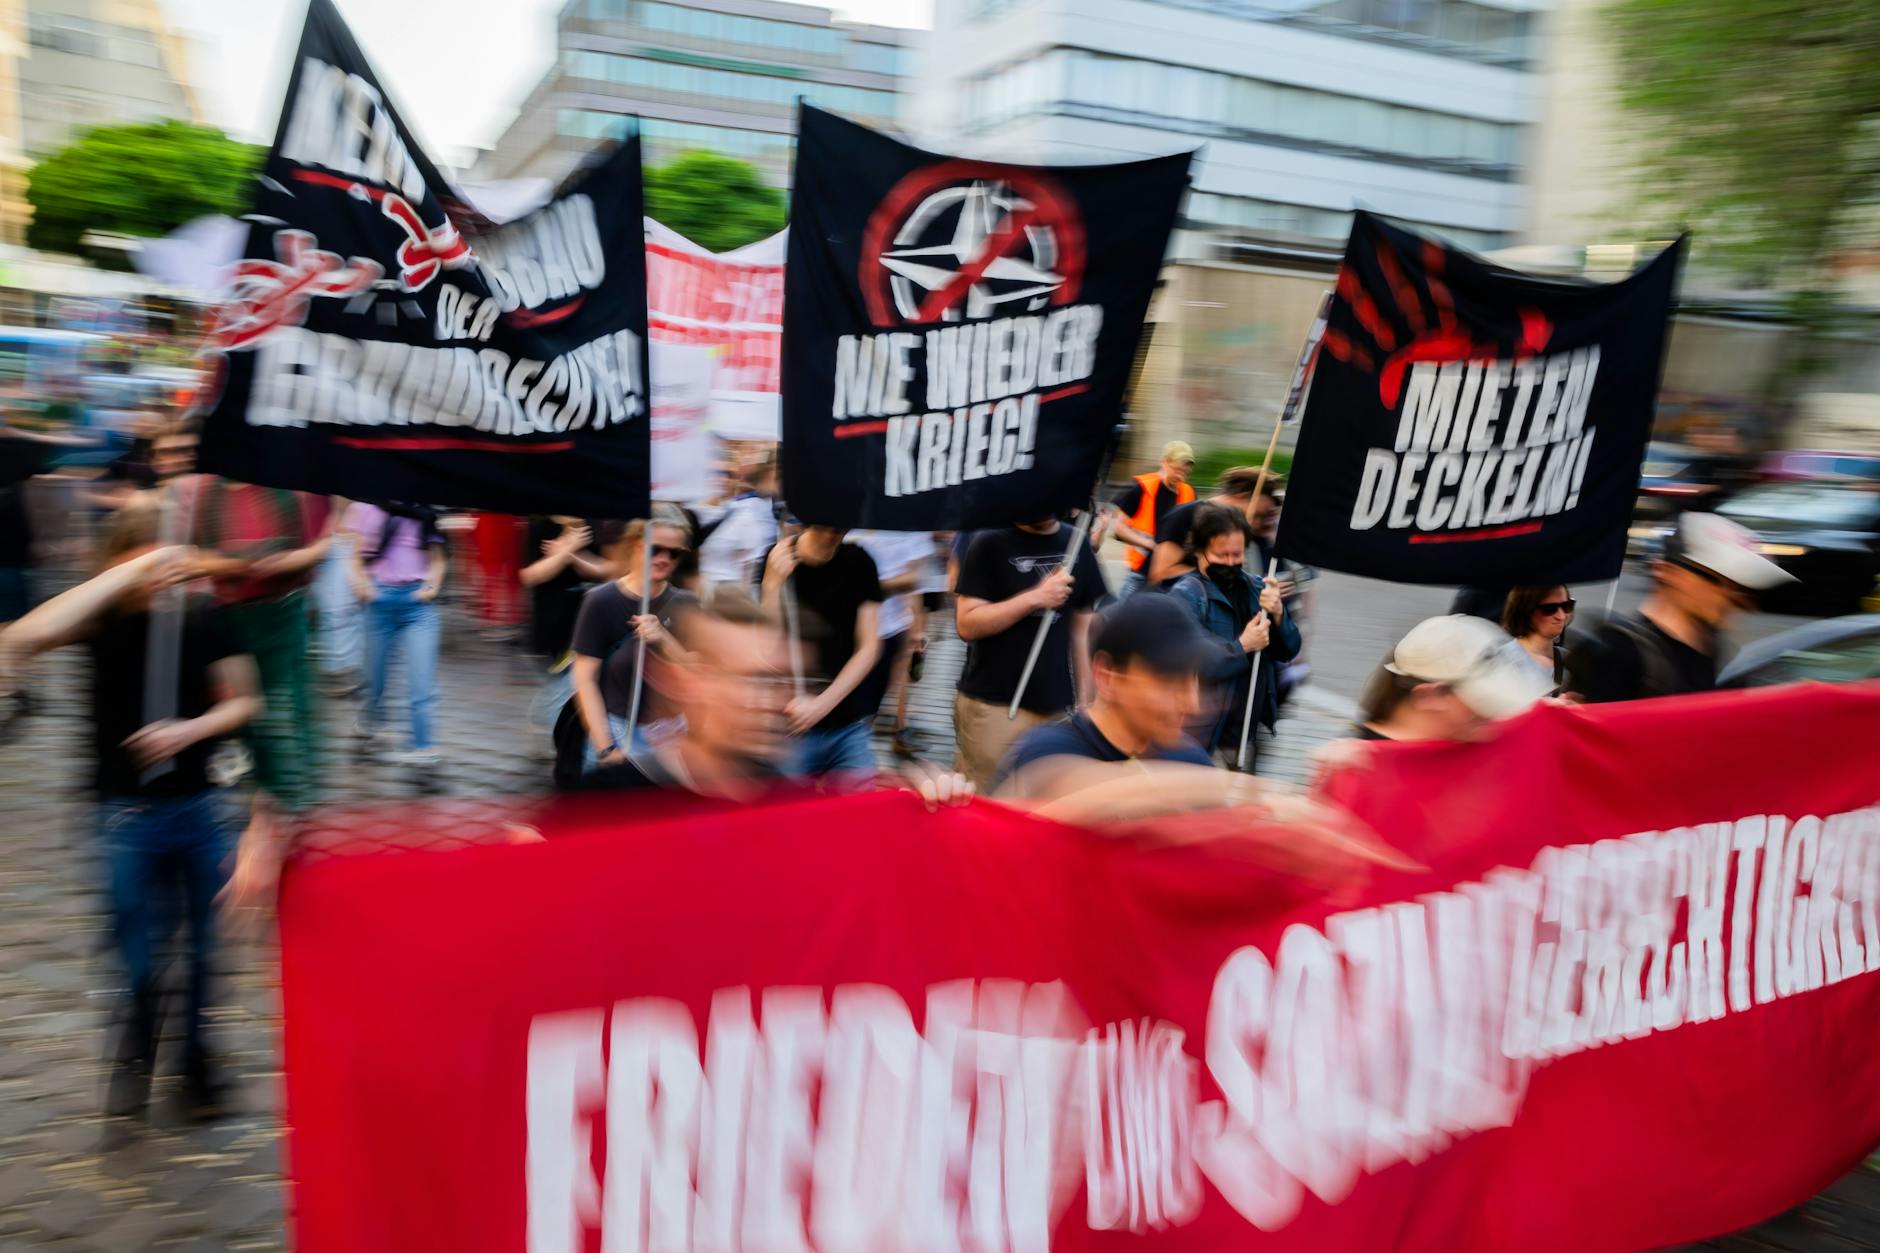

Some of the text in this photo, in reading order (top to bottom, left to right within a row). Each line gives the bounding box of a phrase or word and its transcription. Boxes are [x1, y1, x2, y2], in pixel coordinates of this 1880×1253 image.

[434, 283, 501, 342] DER
[833, 304, 1104, 419] NIE WIEDER
[884, 393, 1041, 497] KRIEG!
[1394, 345, 1602, 453] MIETEN
[1349, 426, 1597, 531] DECKELN!
